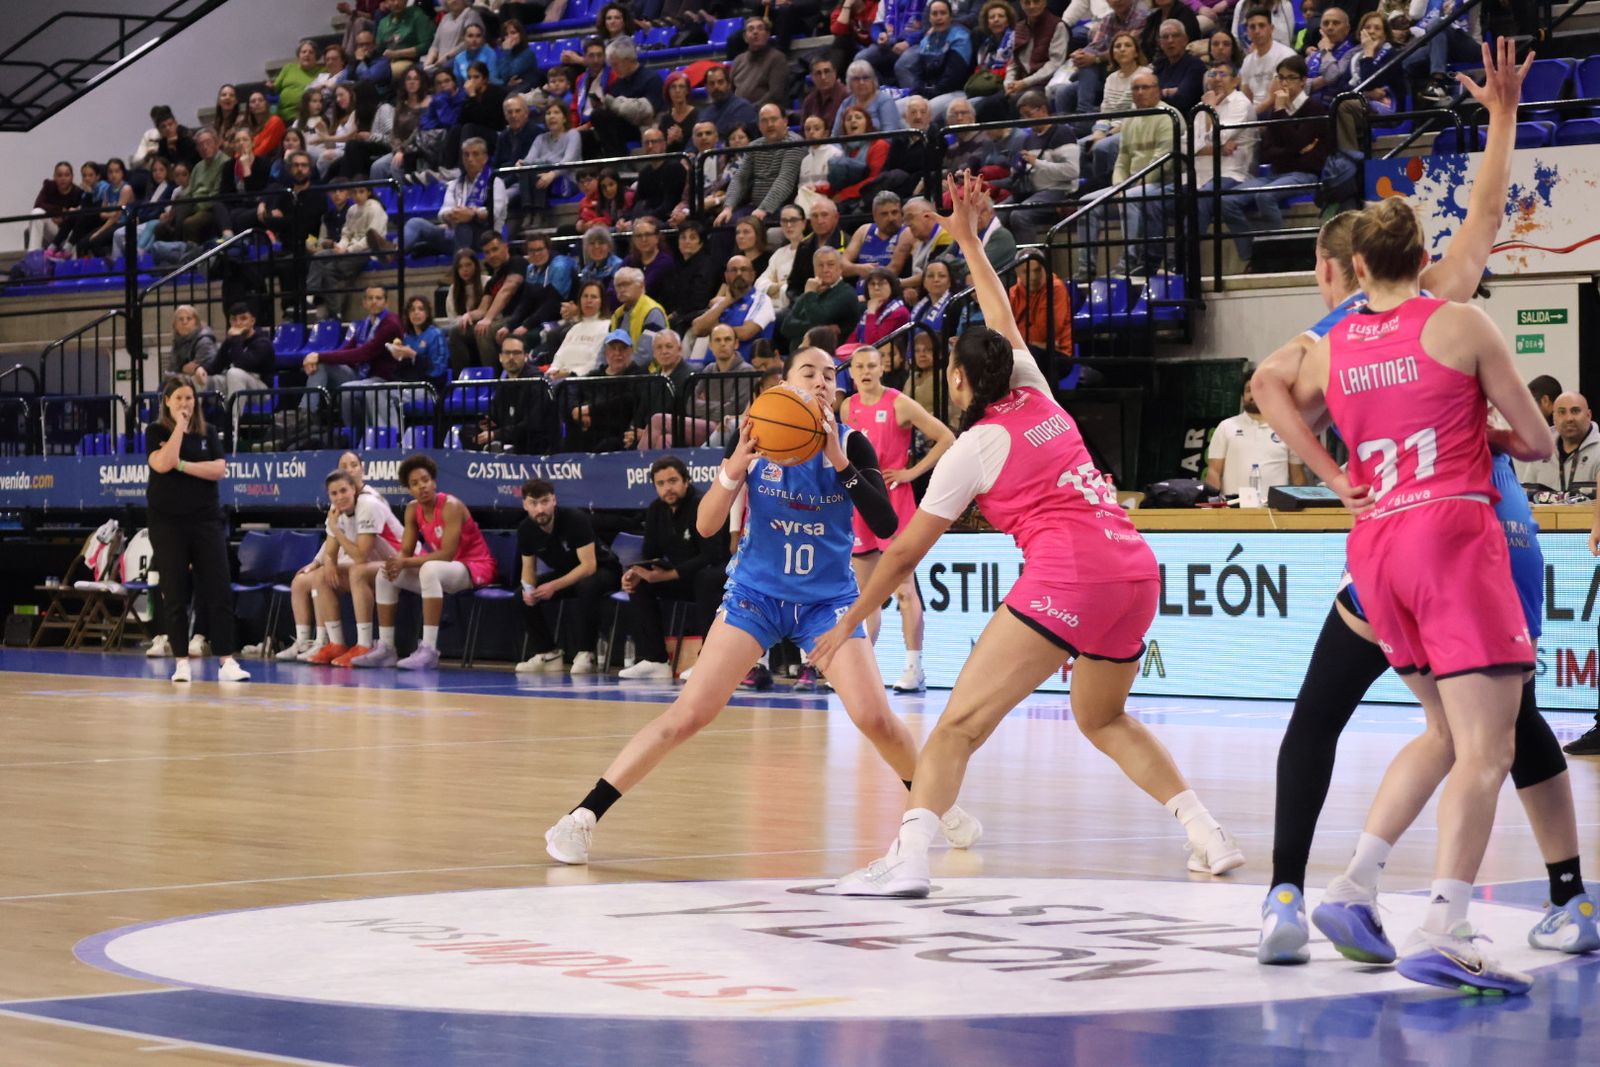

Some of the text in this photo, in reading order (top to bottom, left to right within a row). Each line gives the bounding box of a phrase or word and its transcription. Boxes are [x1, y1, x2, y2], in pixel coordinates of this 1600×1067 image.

[1520, 311, 1551, 324] SALIDA
[1524, 340, 1538, 349] DEA
[1339, 355, 1419, 396] LAHTINEN
[1023, 413, 1071, 448] MORRO
[1180, 428, 1206, 473] AR
[224, 456, 306, 482] STILLA Y LEÓN
[467, 458, 582, 480] CASTILLA Y LEÓN
[1356, 427, 1438, 504] 31
[757, 485, 803, 501] CASTILLA
[809, 494, 817, 504] Y
[783, 542, 815, 575] 10
[1158, 543, 1288, 618] LEÓN
[1047, 607, 1080, 629] eitb
